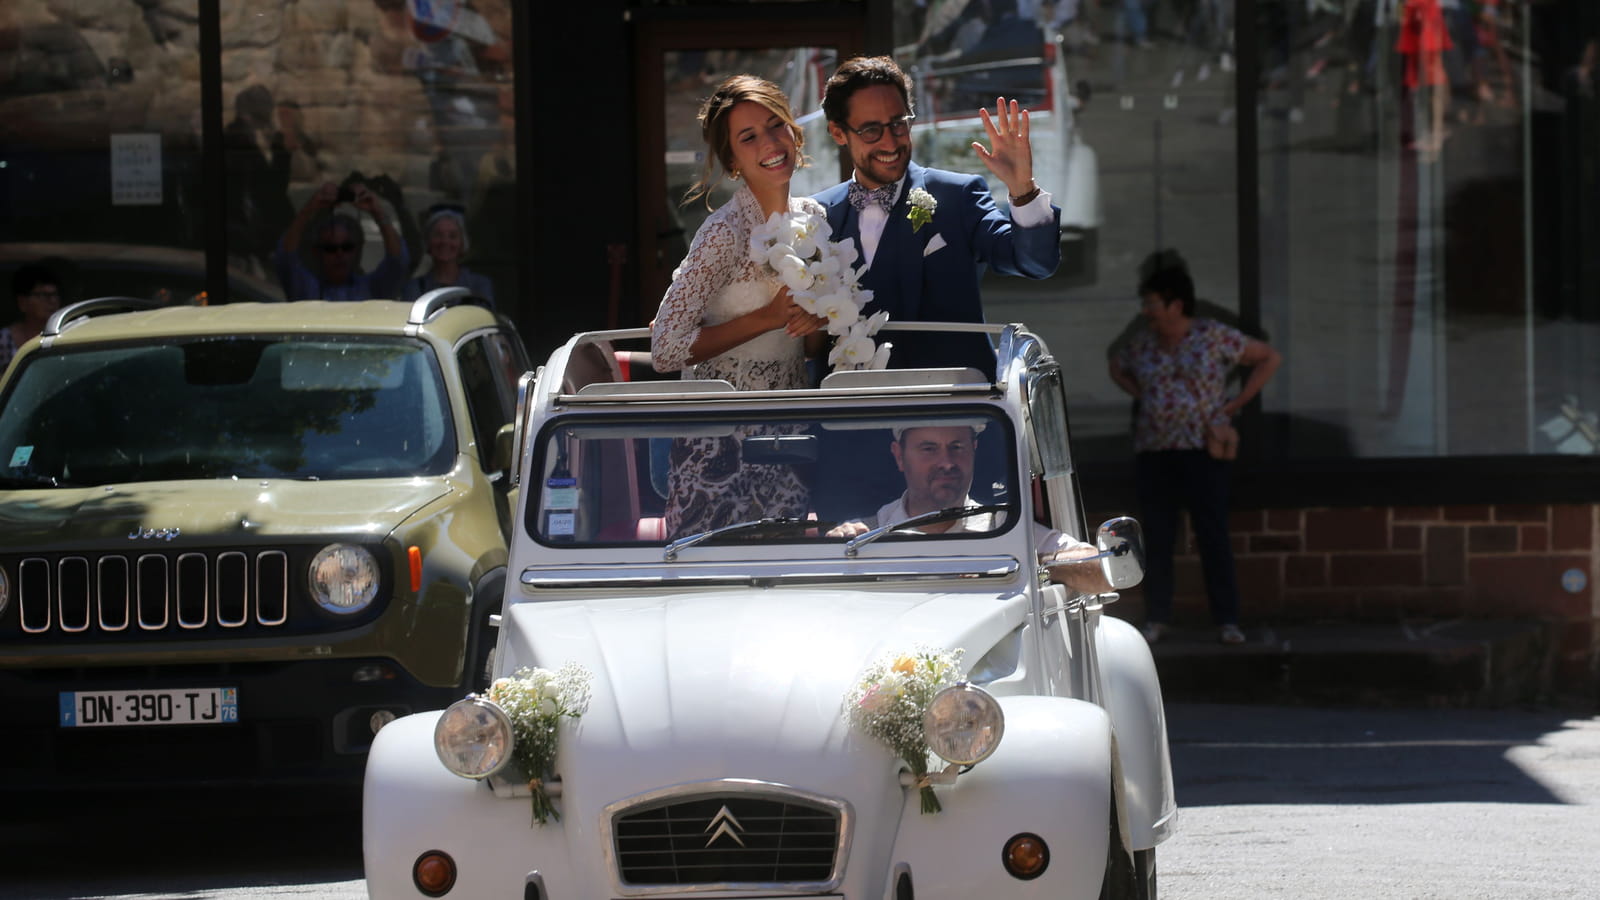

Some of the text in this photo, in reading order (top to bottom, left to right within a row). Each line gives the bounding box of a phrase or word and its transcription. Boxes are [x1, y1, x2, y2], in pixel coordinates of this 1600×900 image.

[128, 526, 181, 541] Jeep
[82, 693, 217, 723] DN-390-TJ
[223, 707, 237, 720] 76
